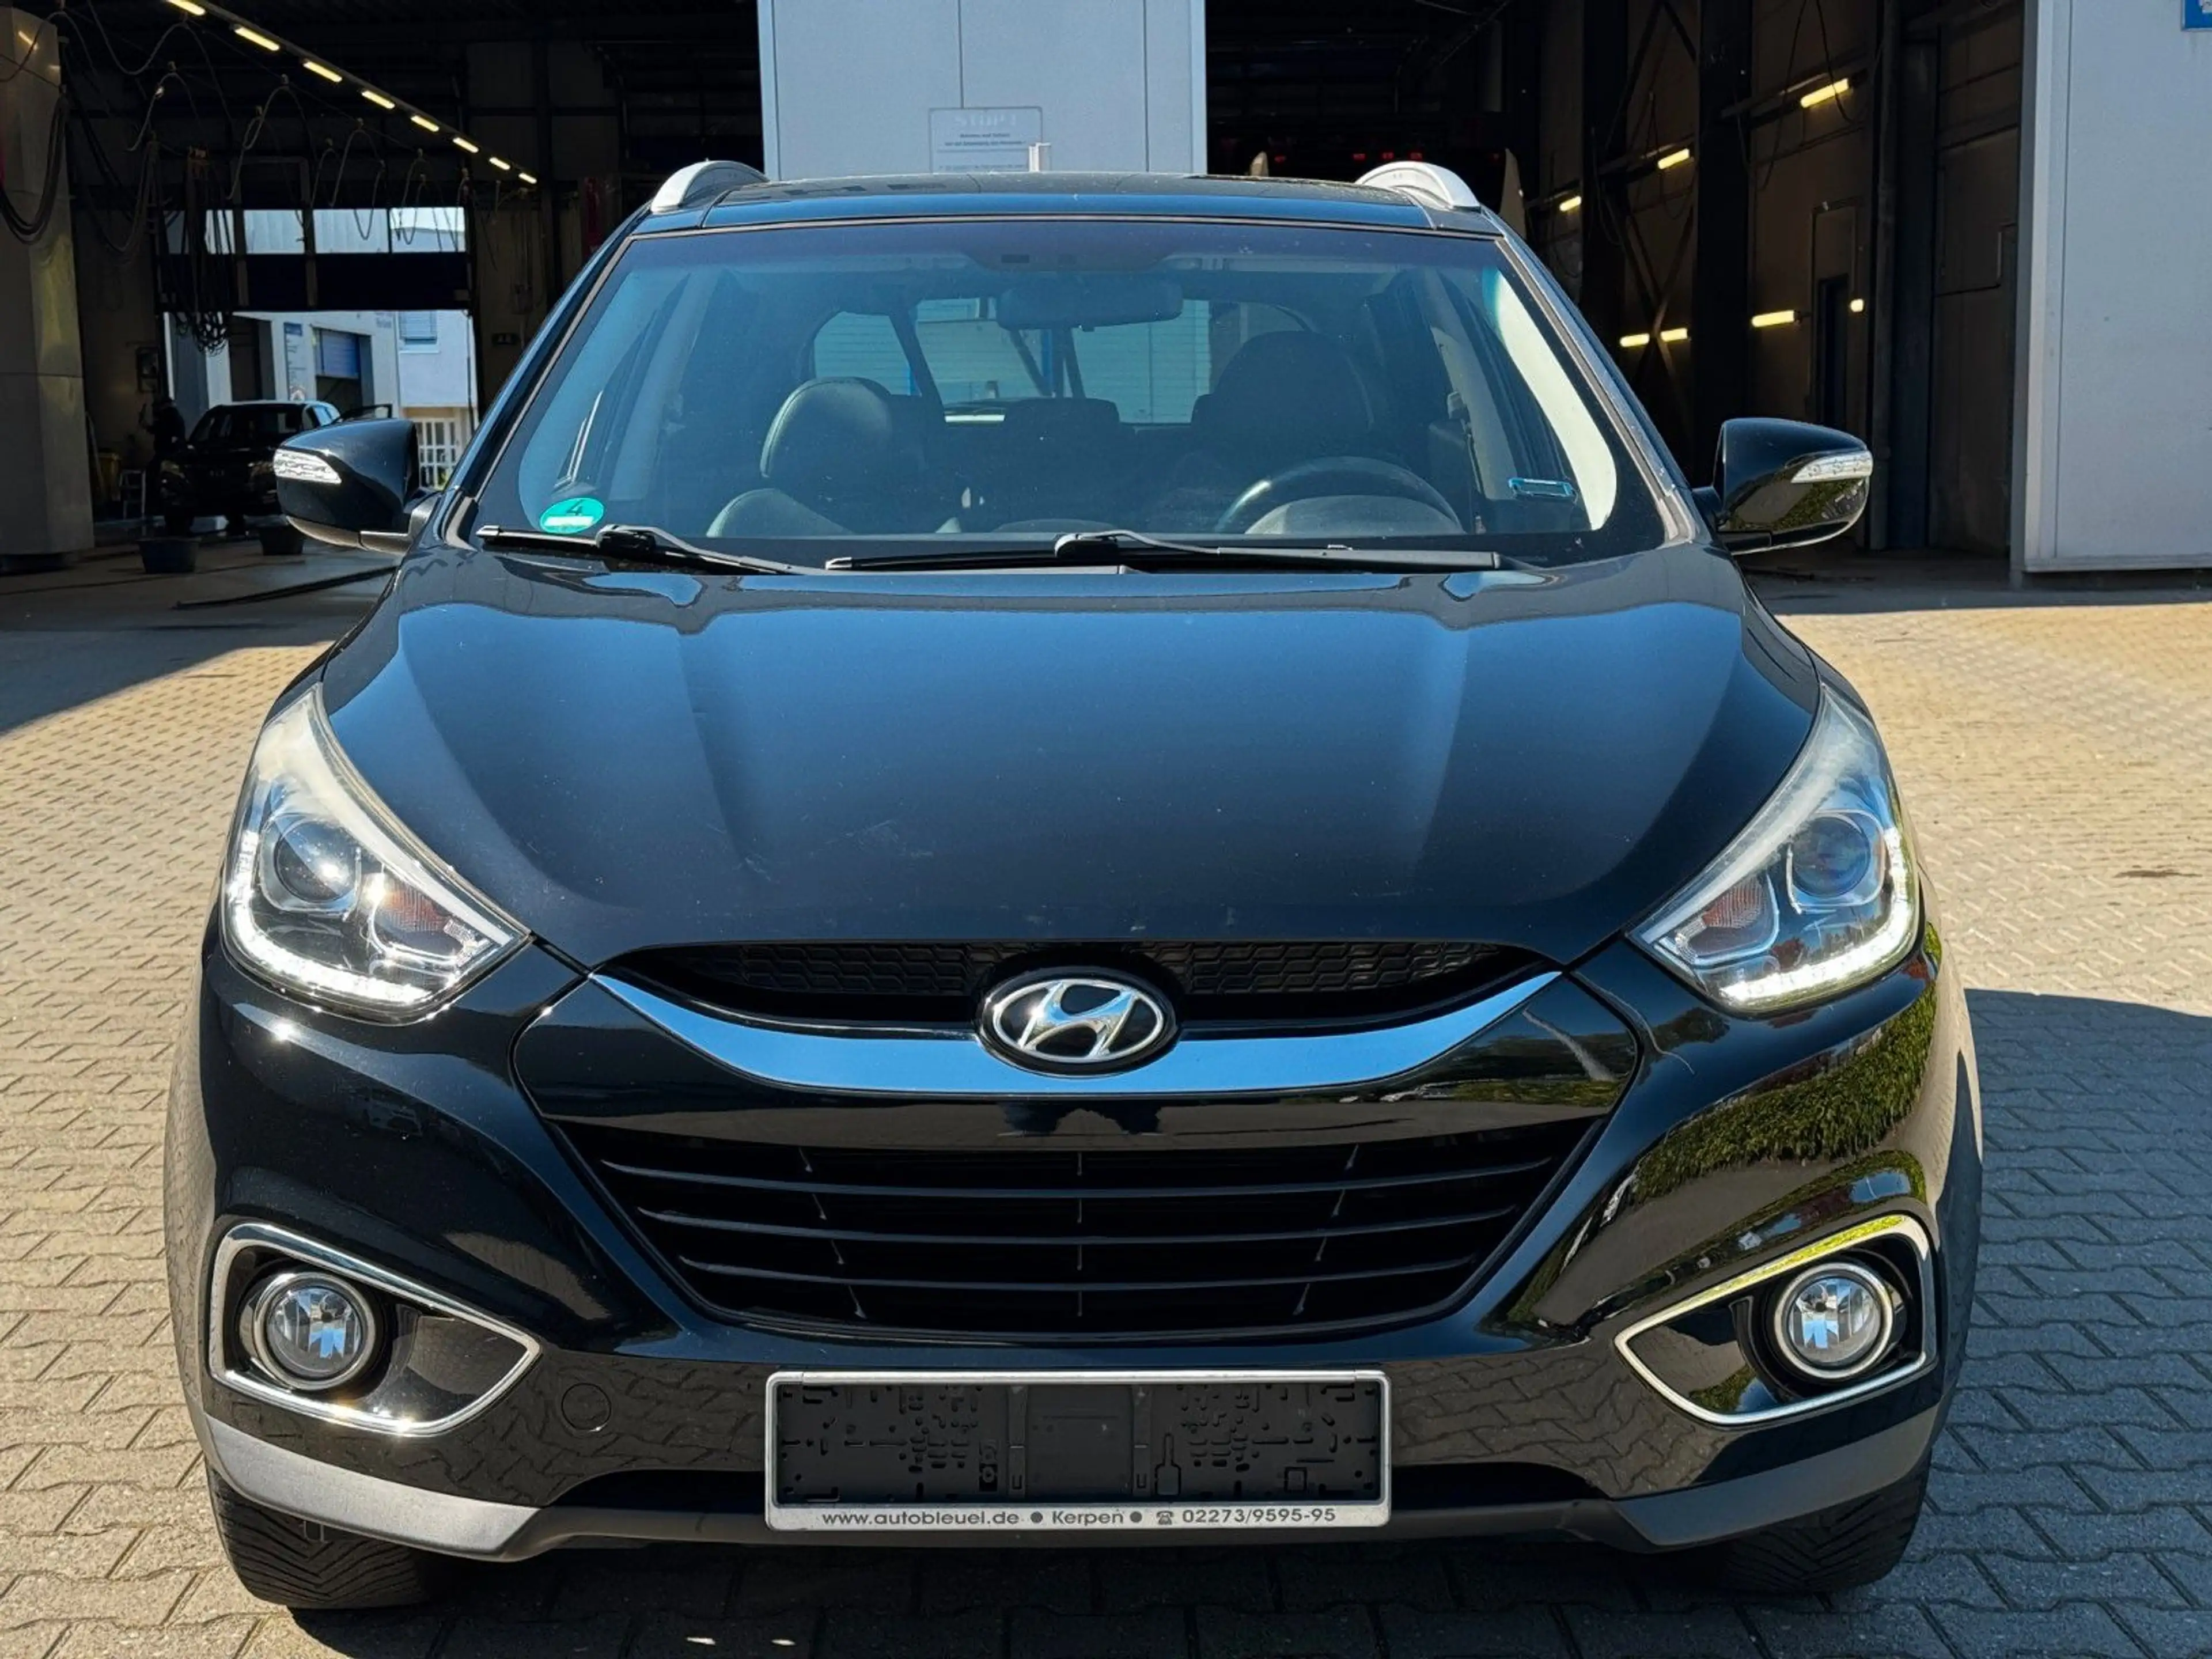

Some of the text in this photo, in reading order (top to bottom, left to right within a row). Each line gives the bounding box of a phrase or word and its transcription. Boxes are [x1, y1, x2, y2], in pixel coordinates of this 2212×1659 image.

[567, 499, 582, 516] 4
[822, 1508, 1336, 1526] www.autobleuel.de Kerpen 02273/9595-95
